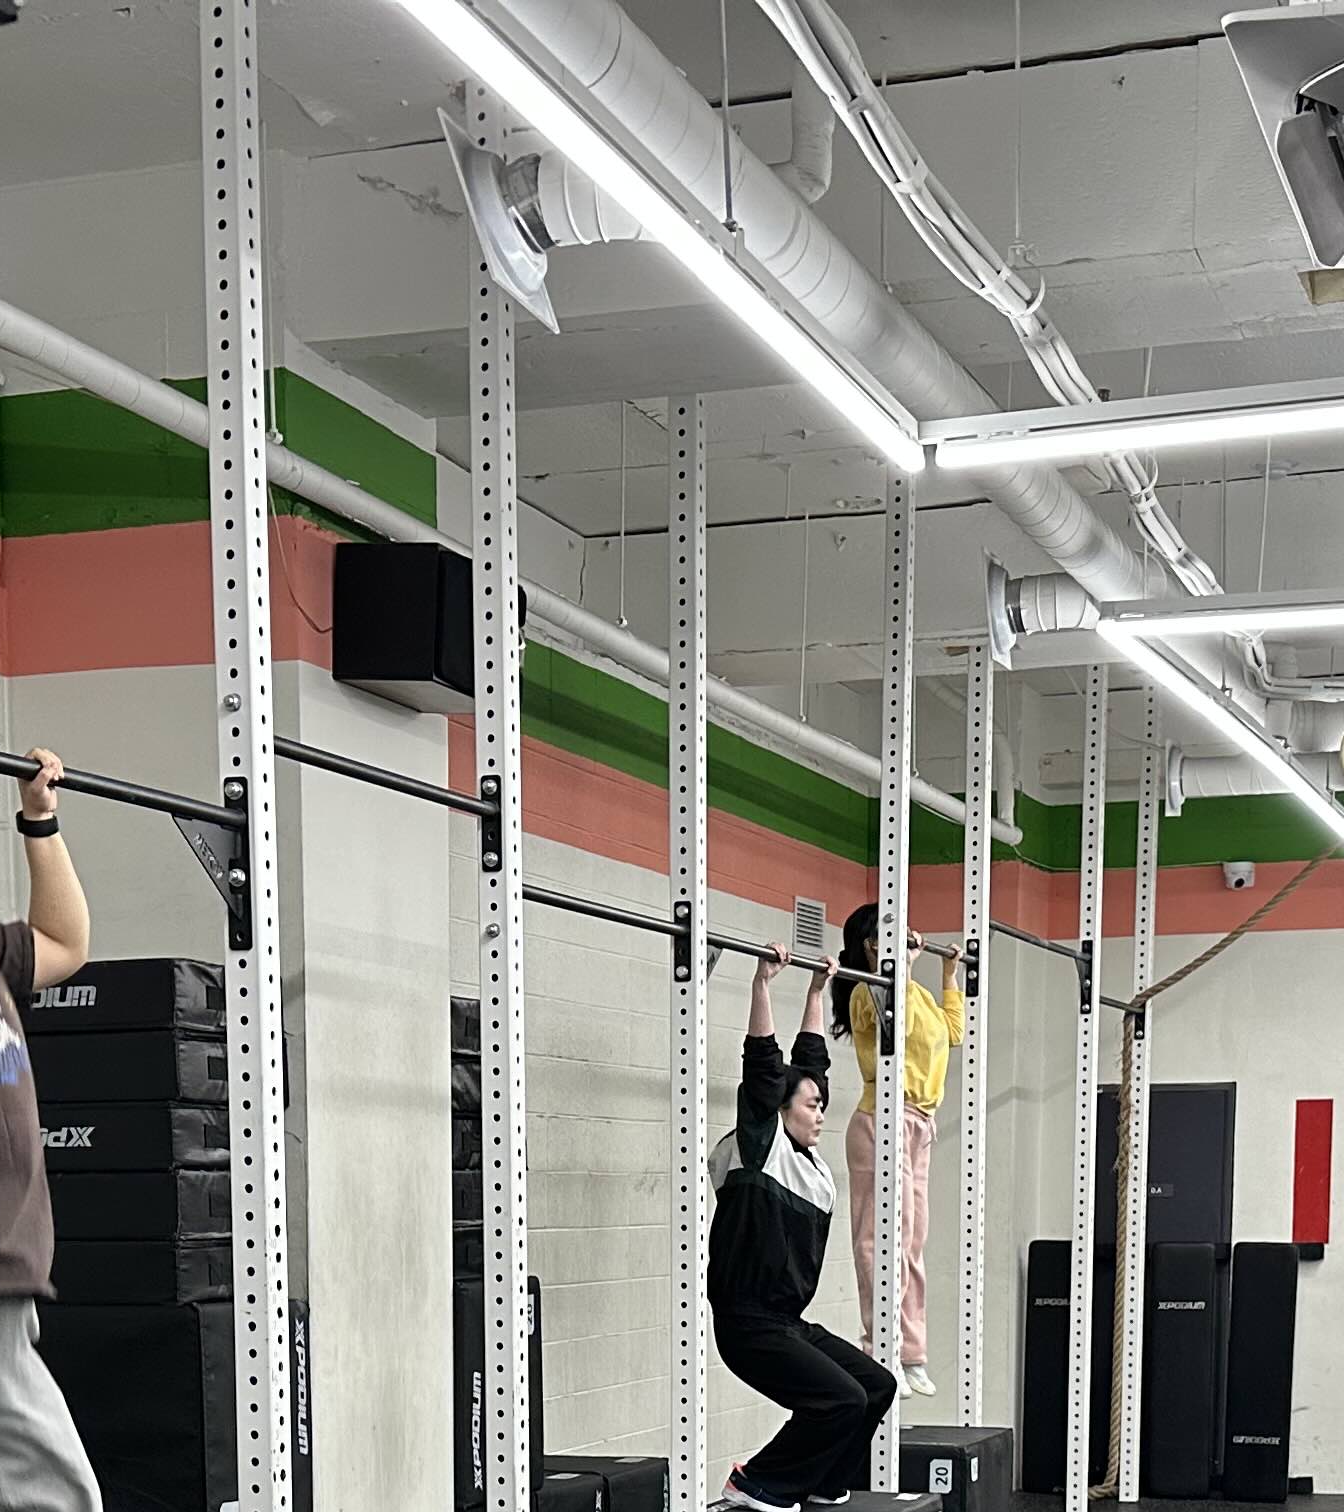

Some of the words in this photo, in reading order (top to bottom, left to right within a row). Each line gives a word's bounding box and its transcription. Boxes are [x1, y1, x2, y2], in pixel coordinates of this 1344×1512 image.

[32, 985, 97, 1008] DIUM
[294, 1317, 309, 1456] XPODIUM
[471, 1371, 484, 1491] XPODIUM
[935, 1466, 949, 1486] 20
